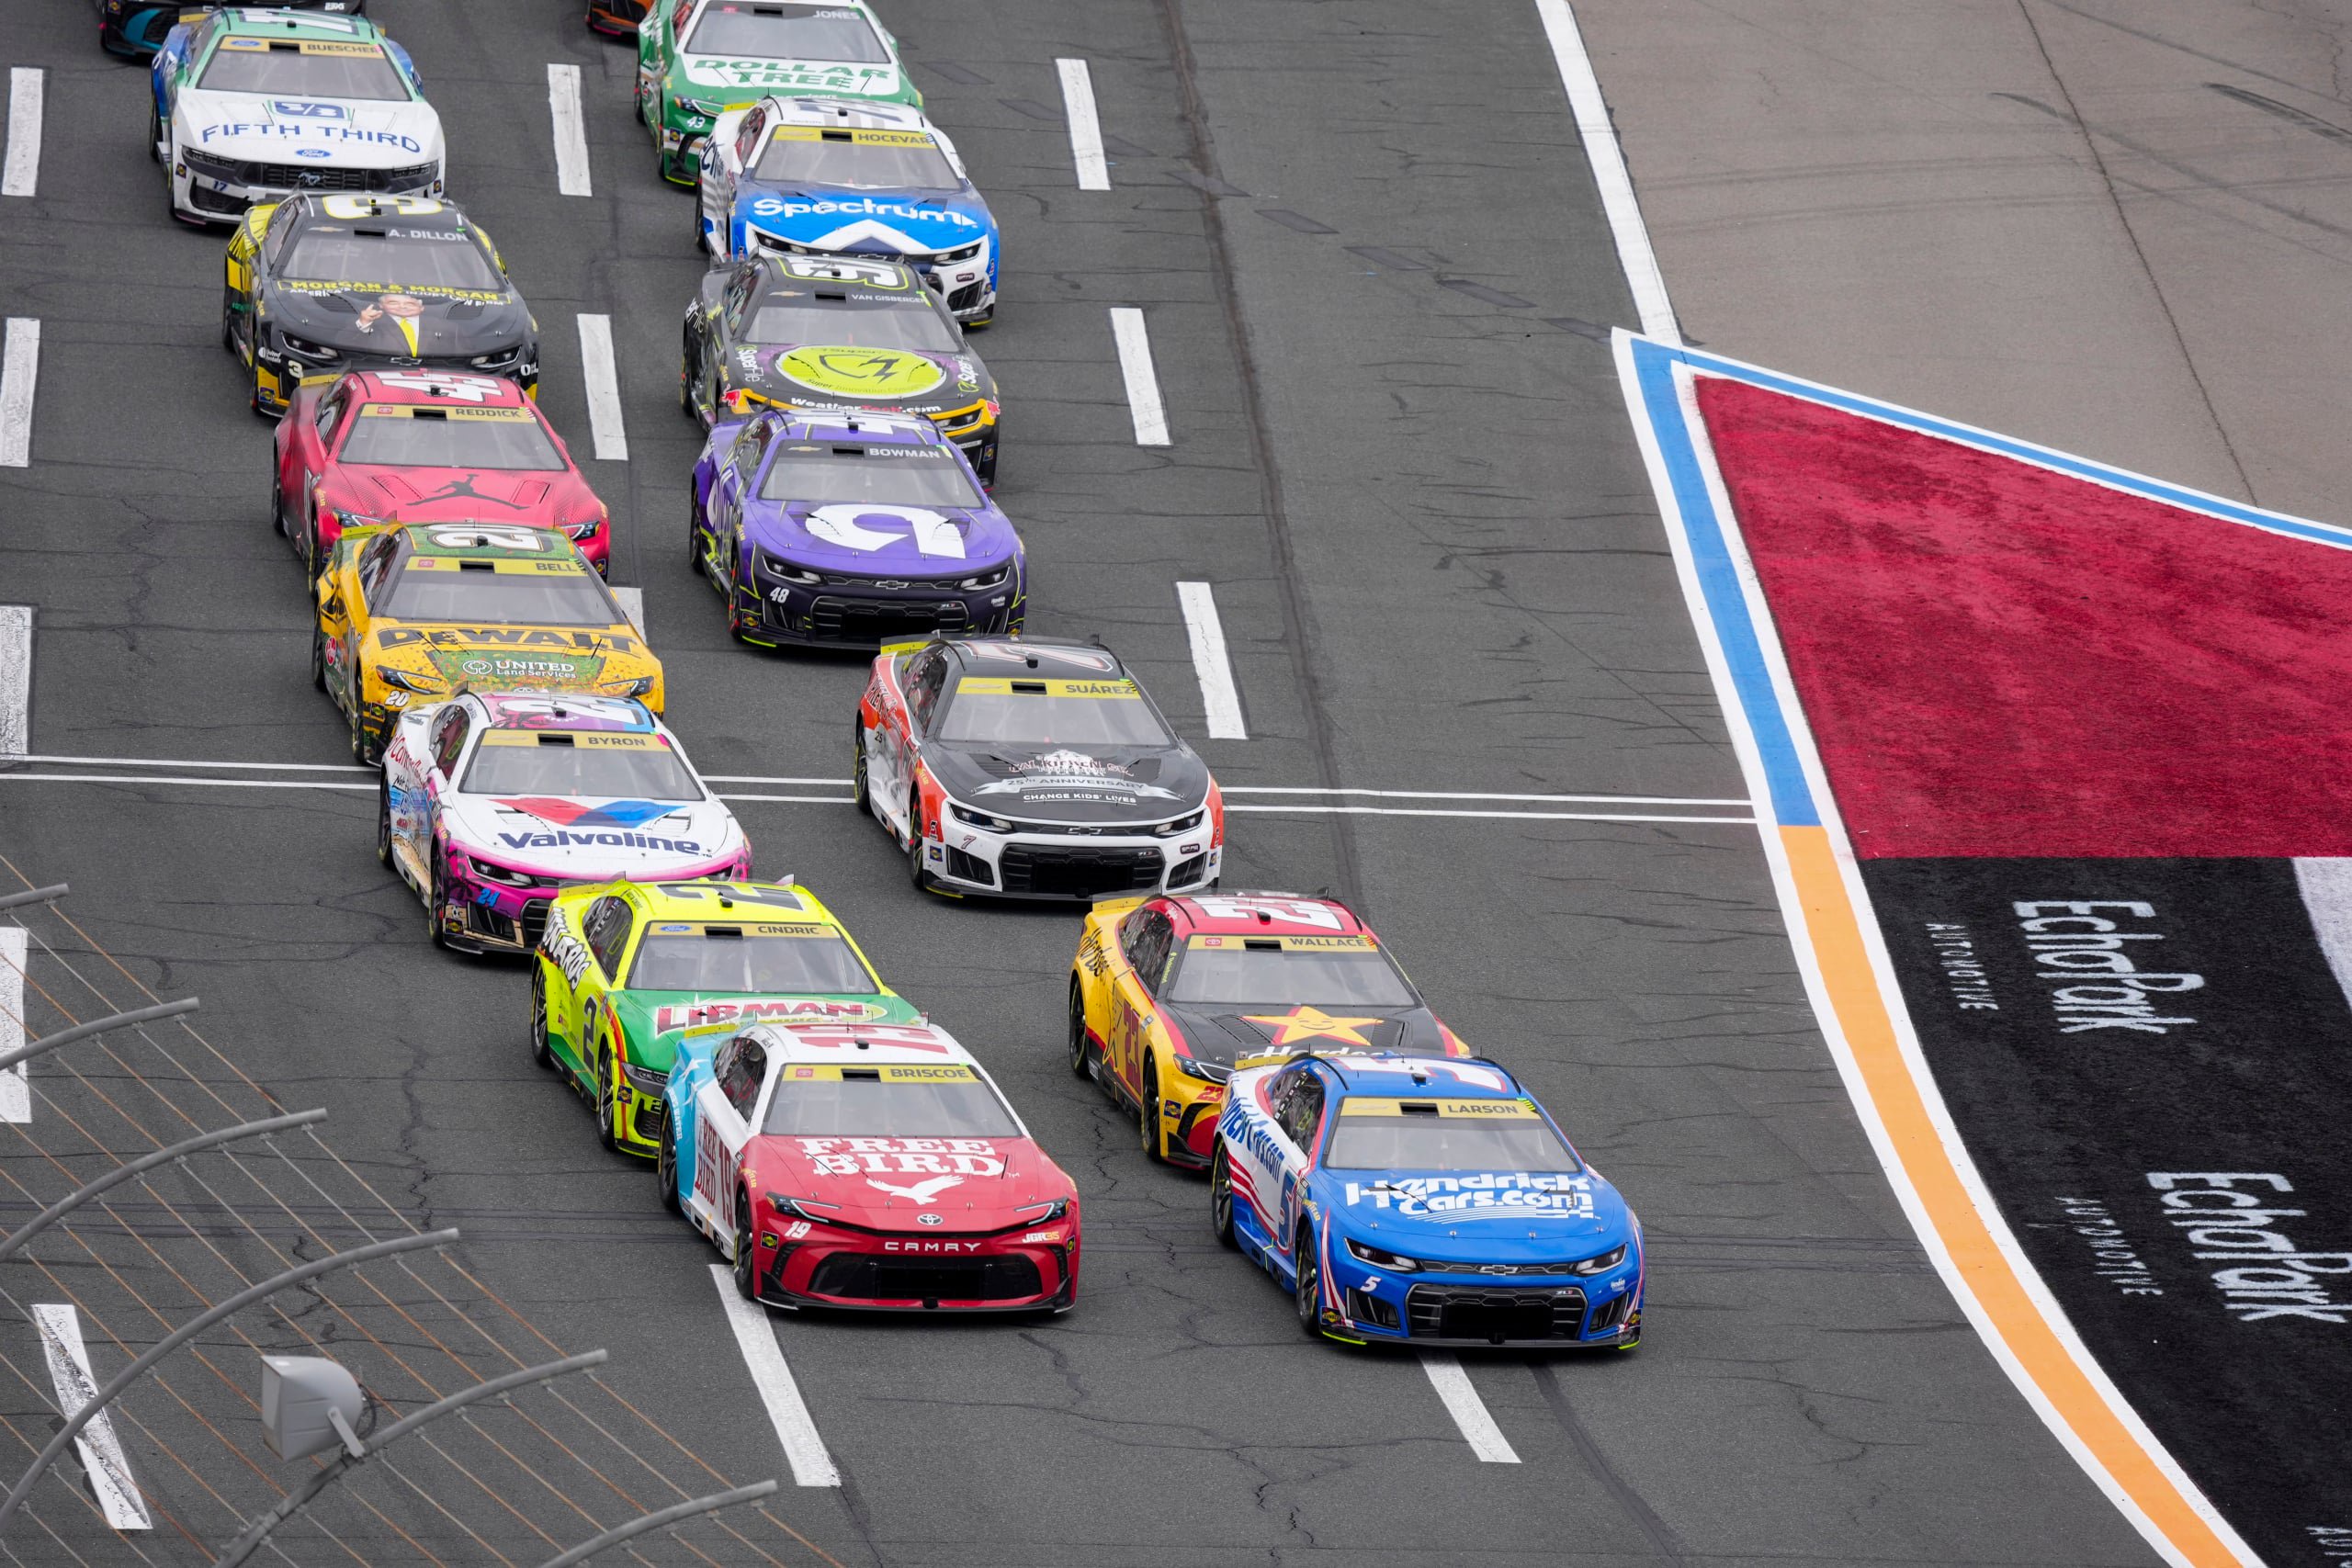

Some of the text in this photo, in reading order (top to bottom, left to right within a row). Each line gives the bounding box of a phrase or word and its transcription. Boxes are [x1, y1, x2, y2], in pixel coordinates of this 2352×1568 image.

[812, 9, 861, 20] JONES
[307, 42, 380, 54] BUESCHER
[693, 59, 890, 80] DOLLAR
[732, 71, 854, 89] TREE
[686, 116, 707, 129] 43
[202, 124, 421, 153] FIFTH THIRD
[857, 132, 931, 145] HOCEVAR
[212, 180, 228, 192] 17
[753, 197, 978, 228] Spectrum
[388, 229, 469, 243] A. DILLON
[290, 280, 382, 290] MORGAN
[409, 285, 498, 301] MORGAN
[851, 293, 928, 304] VAN GISBERGEN
[288, 360, 304, 378] 3
[455, 407, 521, 418] REDDICK
[869, 446, 940, 459] BOWMAN
[536, 561, 578, 573] BELL
[769, 585, 790, 604] 48
[377, 628, 641, 659] DEWALT
[495, 660, 576, 672] UNITED
[496, 668, 577, 680] Land Services
[1065, 683, 1136, 695] SUÁREZ
[384, 691, 411, 707] 20
[587, 737, 647, 747] BYRON
[874, 730, 883, 743] 25
[1037, 777, 1145, 790] ANNIVERSARY
[1023, 792, 1137, 804] CHANGE KIDS' LIVES
[498, 830, 701, 856] Valvoline
[960, 835, 977, 850] 7
[478, 888, 501, 908] 24
[757, 925, 820, 935] CINDRIC
[1288, 937, 1367, 948] WALLACE
[1926, 922, 2000, 1011] AUTOMOTIVE
[2012, 900, 2205, 1034] EchoPark
[582, 993, 598, 1077] 2
[889, 1068, 969, 1079] BRISCOE
[1197, 1085, 1225, 1102] 23
[1447, 1104, 1519, 1115] LARSON
[698, 1114, 718, 1168] FREE
[796, 1137, 997, 1156] FREE
[805, 1153, 1005, 1177] BIRD
[695, 1153, 717, 1208] BIRD
[719, 1139, 734, 1232] 19
[1345, 1172, 1590, 1208] Hendrick
[1397, 1190, 1595, 1216] Cars.com
[784, 1221, 812, 1239] 19
[1022, 1231, 1060, 1244] JGR35
[884, 1241, 983, 1252] CAMRY
[2054, 1196, 2163, 1295] AUTOMOTIVE
[2144, 1172, 2352, 1323] EchoPark
[1361, 1276, 1381, 1293] 5
